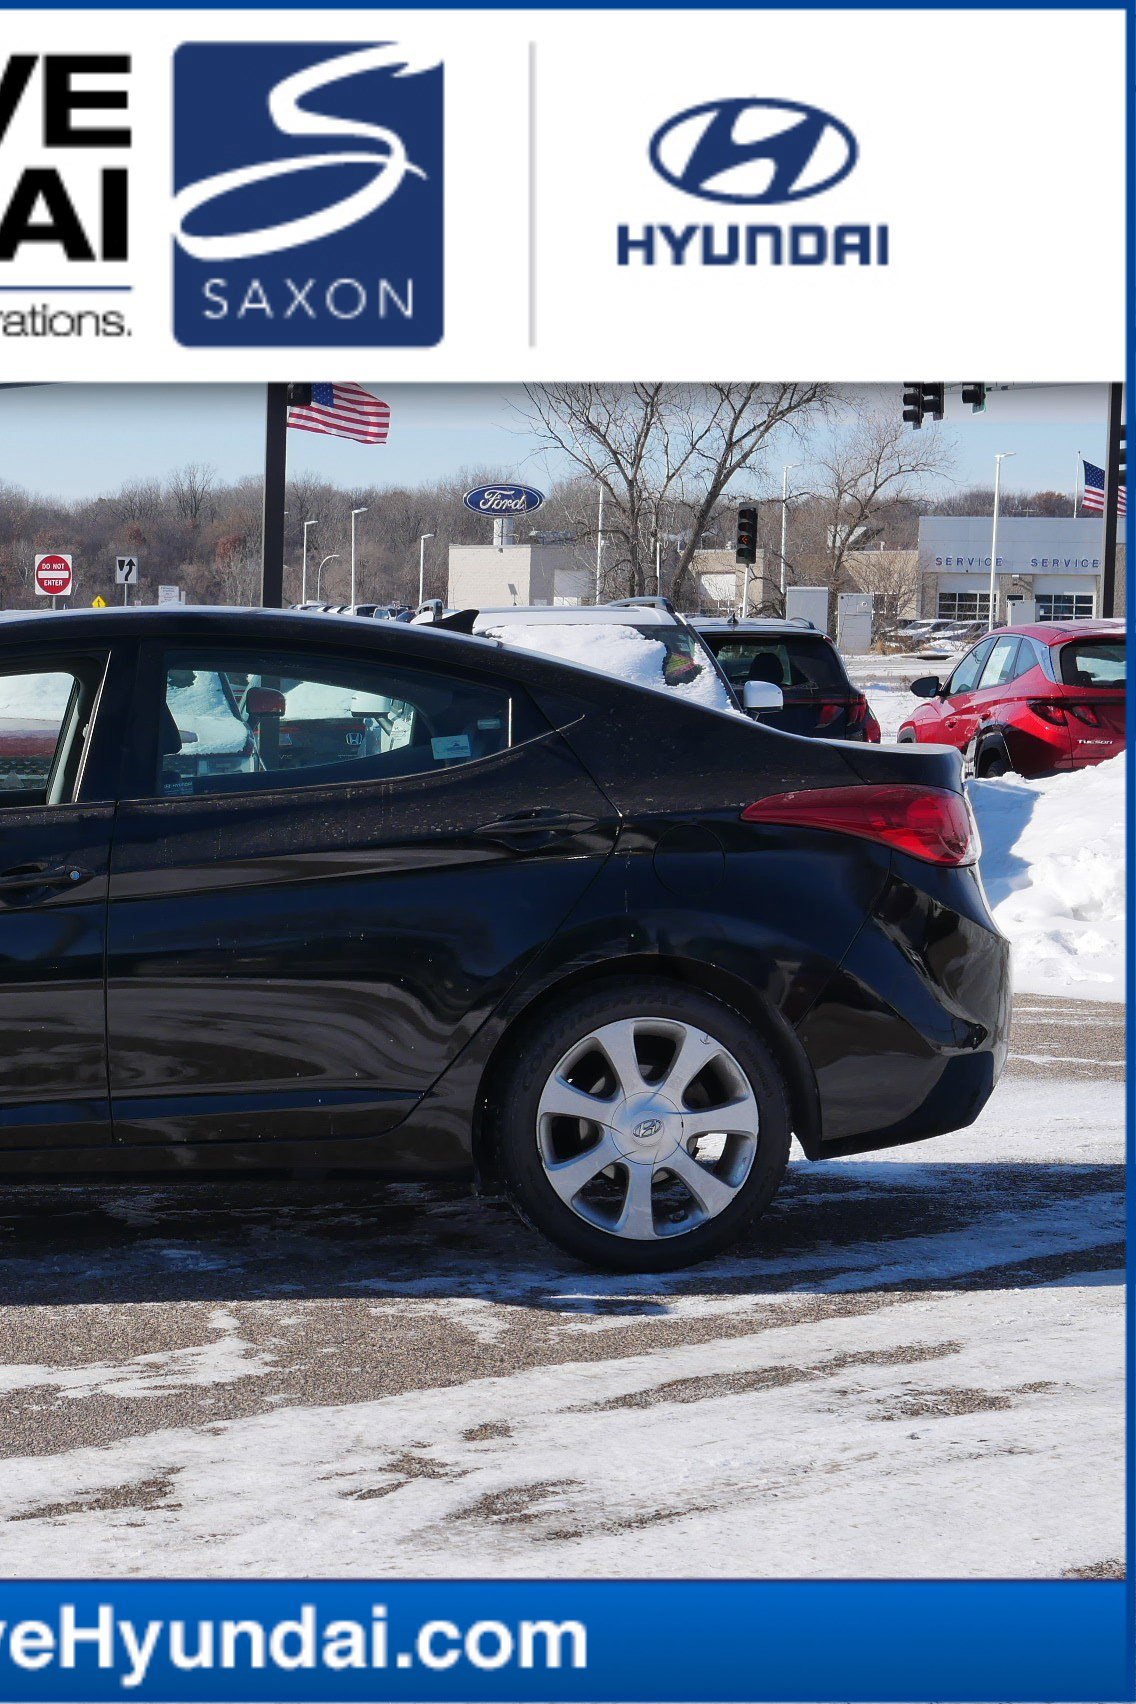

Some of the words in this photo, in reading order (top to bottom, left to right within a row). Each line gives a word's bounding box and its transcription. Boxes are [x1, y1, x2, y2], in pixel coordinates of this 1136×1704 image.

[480, 489, 527, 510] Ford
[935, 557, 1003, 567] SERVICE
[1030, 558, 1100, 568] SERVICE
